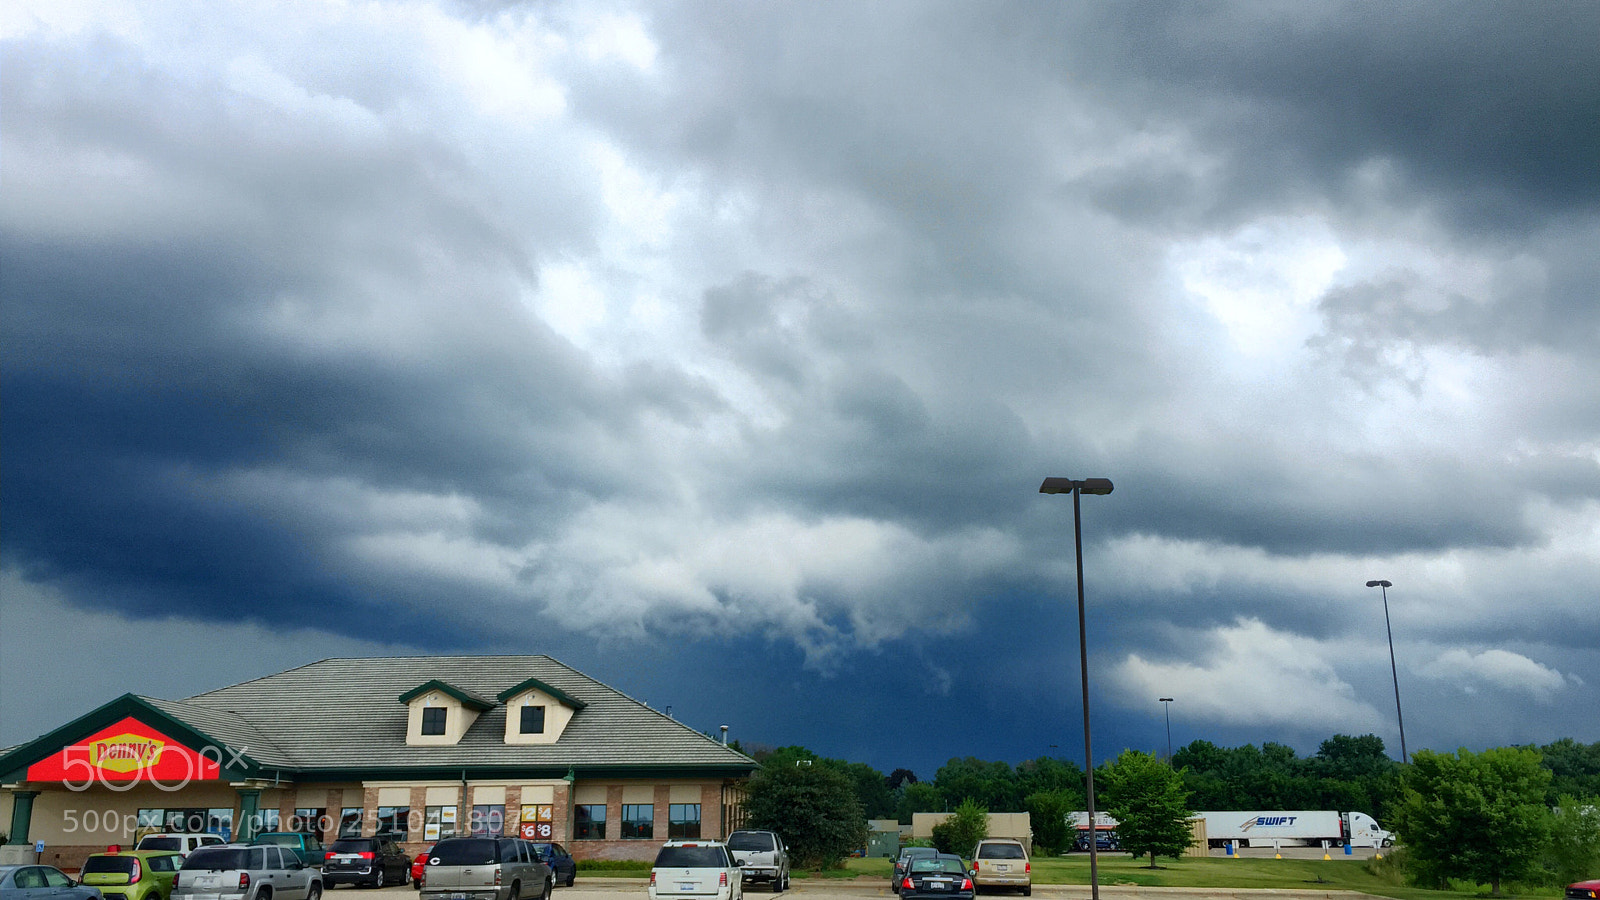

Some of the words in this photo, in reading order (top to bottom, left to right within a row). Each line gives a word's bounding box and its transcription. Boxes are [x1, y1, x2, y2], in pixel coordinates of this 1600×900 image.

[97, 741, 156, 762] Denny's
[538, 807, 552, 819] $4
[1256, 816, 1297, 825] SWIFT
[521, 825, 534, 837] $6
[537, 824, 551, 836] $8
